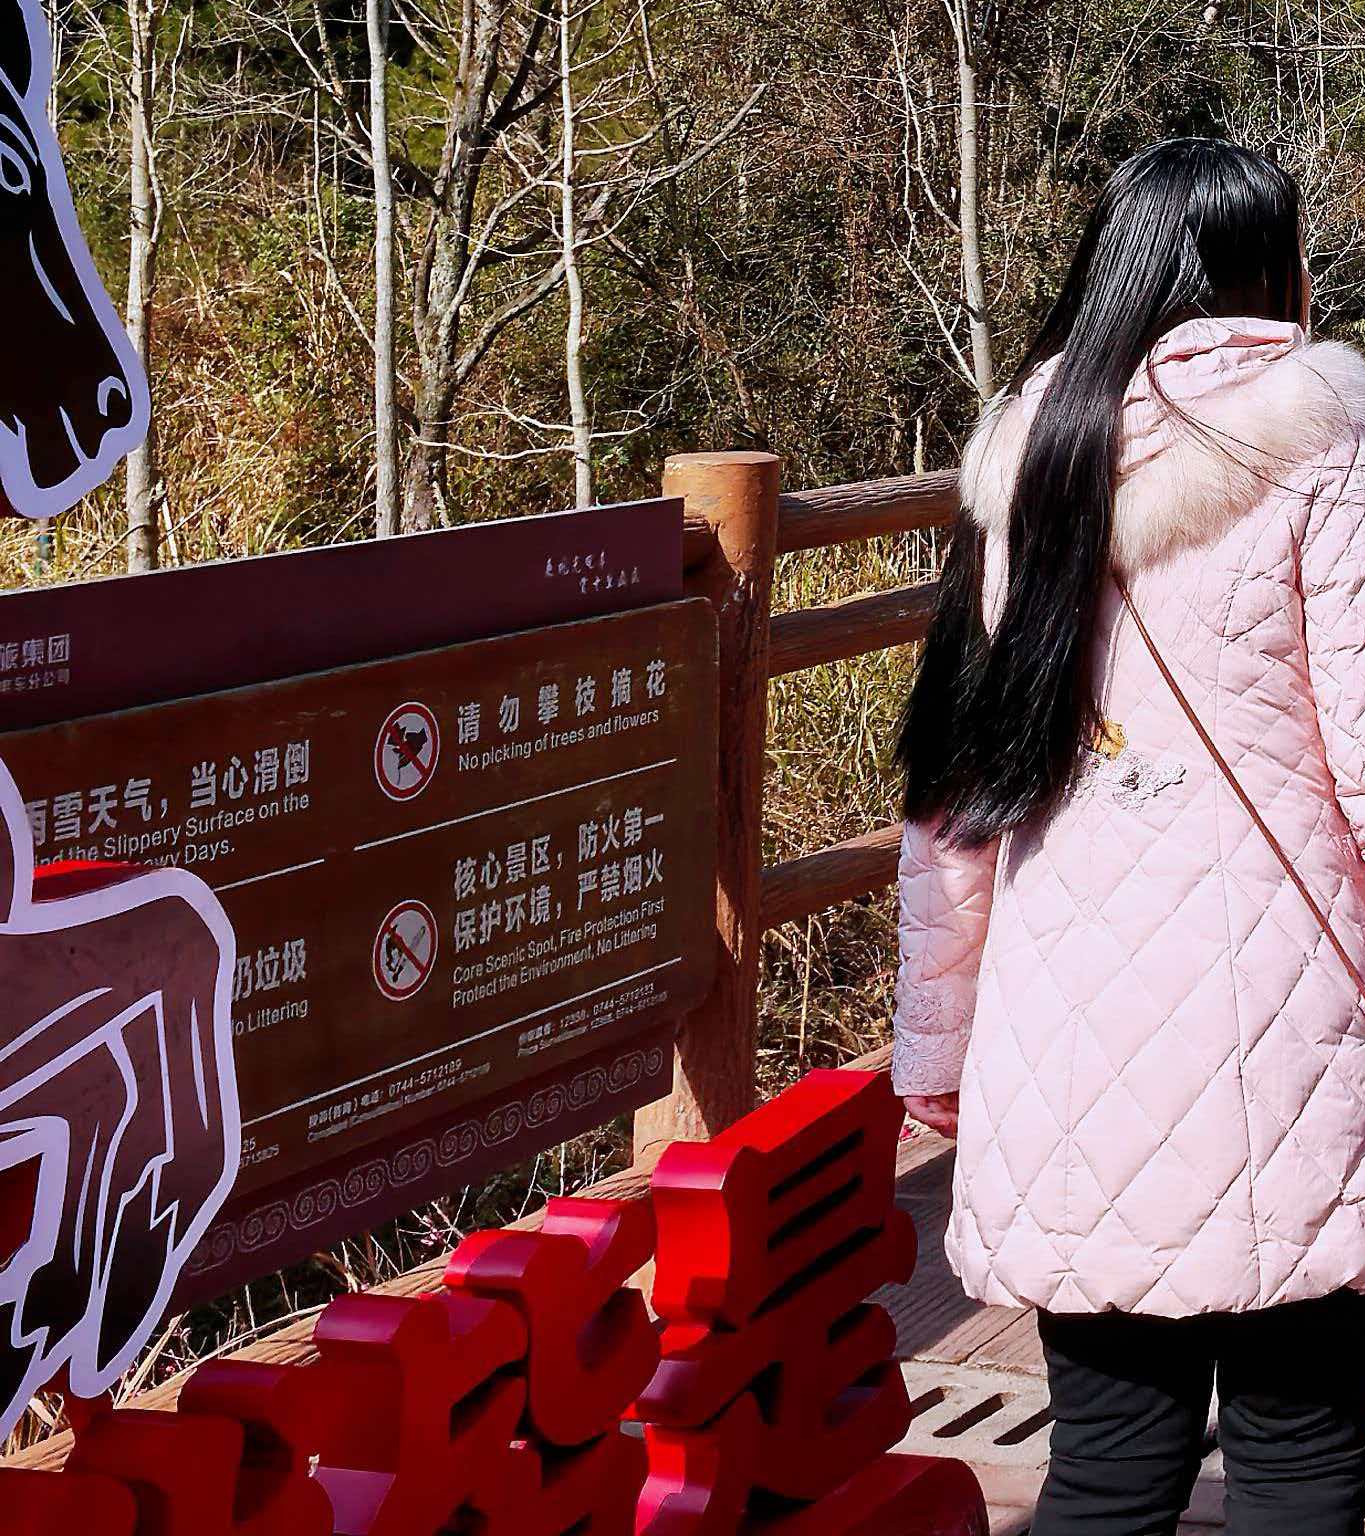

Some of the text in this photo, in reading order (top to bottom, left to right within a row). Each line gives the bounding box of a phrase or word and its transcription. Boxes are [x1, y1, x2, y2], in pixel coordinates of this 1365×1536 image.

[457, 658, 667, 745] 请勿攀枝摘花
[458, 709, 659, 772] No picking of trees and flowers
[35, 848, 63, 868] ind
[104, 824, 182, 858] Slippery
[185, 806, 255, 837] Surface
[258, 800, 280, 820] on
[283, 791, 310, 814] the
[184, 839, 236, 865] Days.
[453, 965, 483, 985] Core
[486, 948, 525, 974] Scenic
[560, 927, 582, 948] Fire
[584, 908, 639, 937] Protection
[641, 896, 665, 917] First
[453, 978, 497, 1009] Protect
[499, 973, 518, 991] the
[597, 938, 612, 957] No
[614, 922, 657, 949] Littering
[248, 999, 308, 1033] Littering
